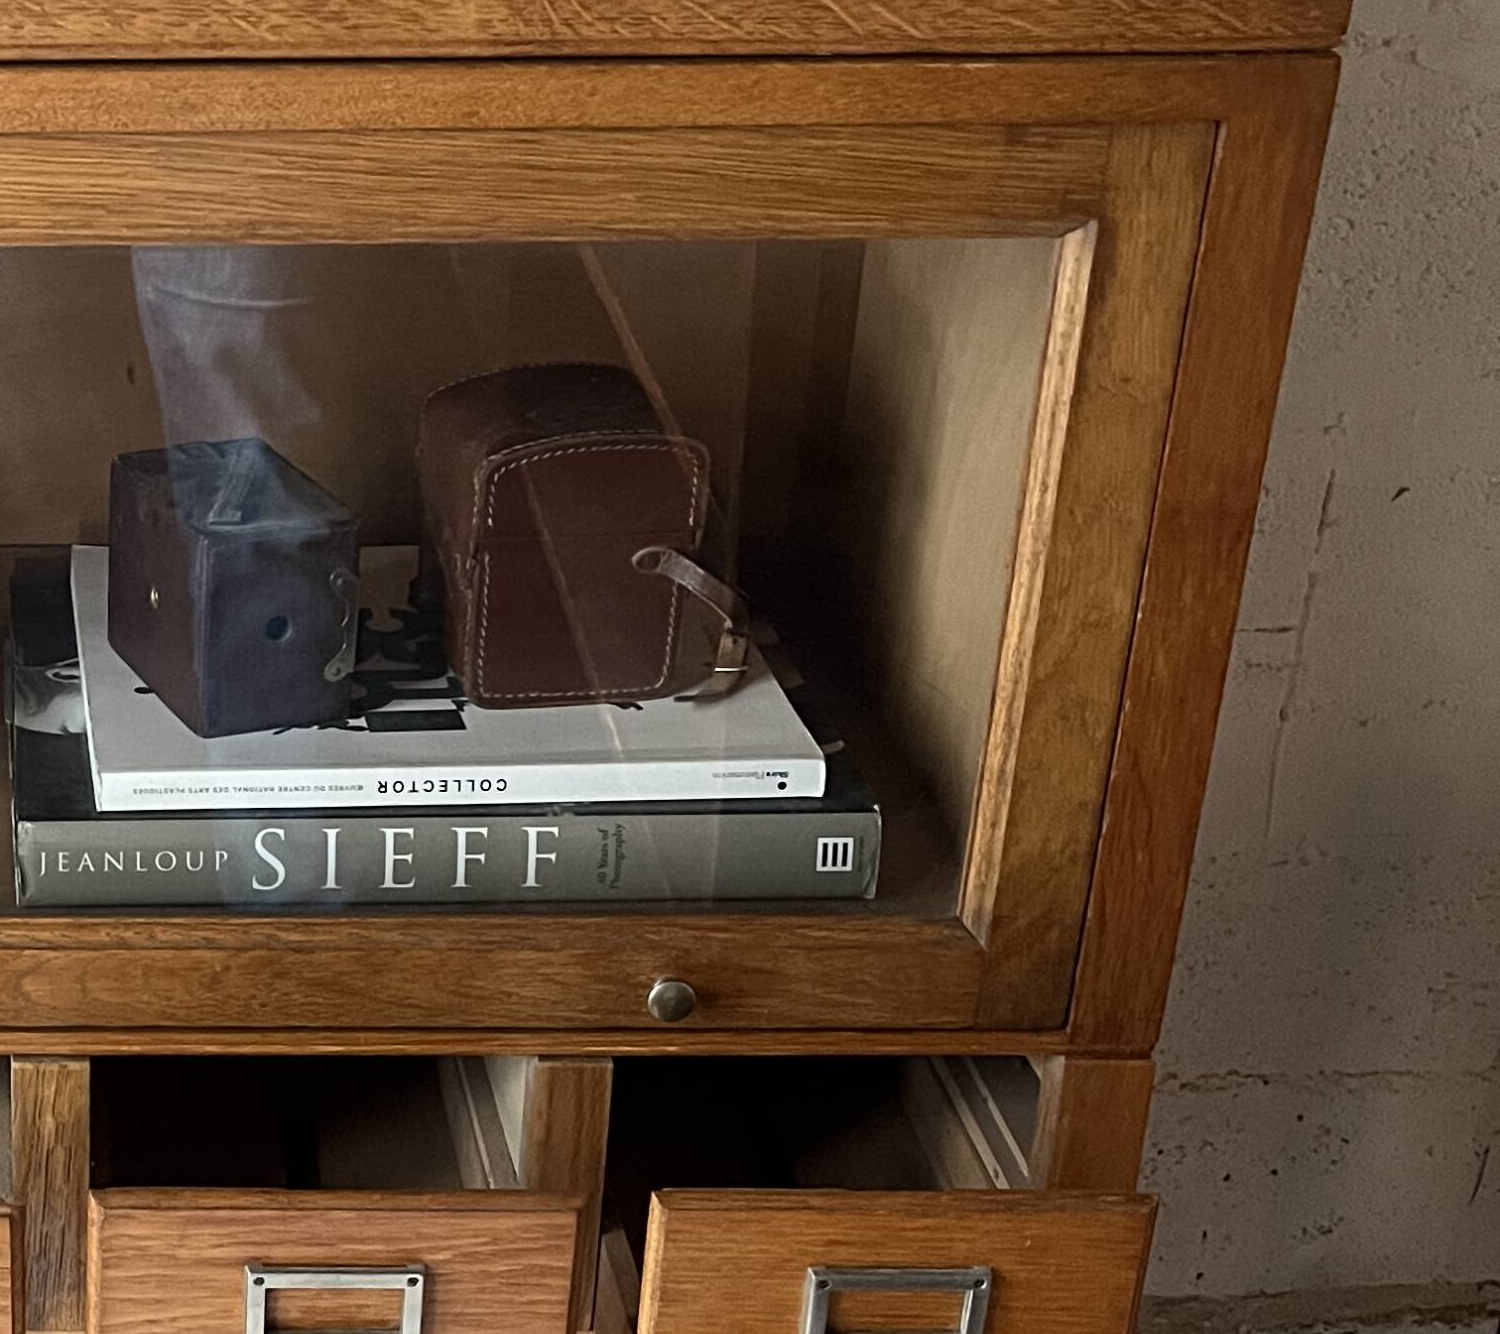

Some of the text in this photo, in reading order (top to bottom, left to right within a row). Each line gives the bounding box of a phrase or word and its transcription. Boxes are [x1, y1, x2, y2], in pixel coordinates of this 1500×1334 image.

[233, 786, 275, 794] NATIONAL
[377, 778, 508, 794] COLLECTOR
[597, 827, 609, 842] of
[38, 826, 560, 891] JEANLOUP SIEFF
[598, 844, 609, 873] Years
[609, 822, 626, 889] Photography
